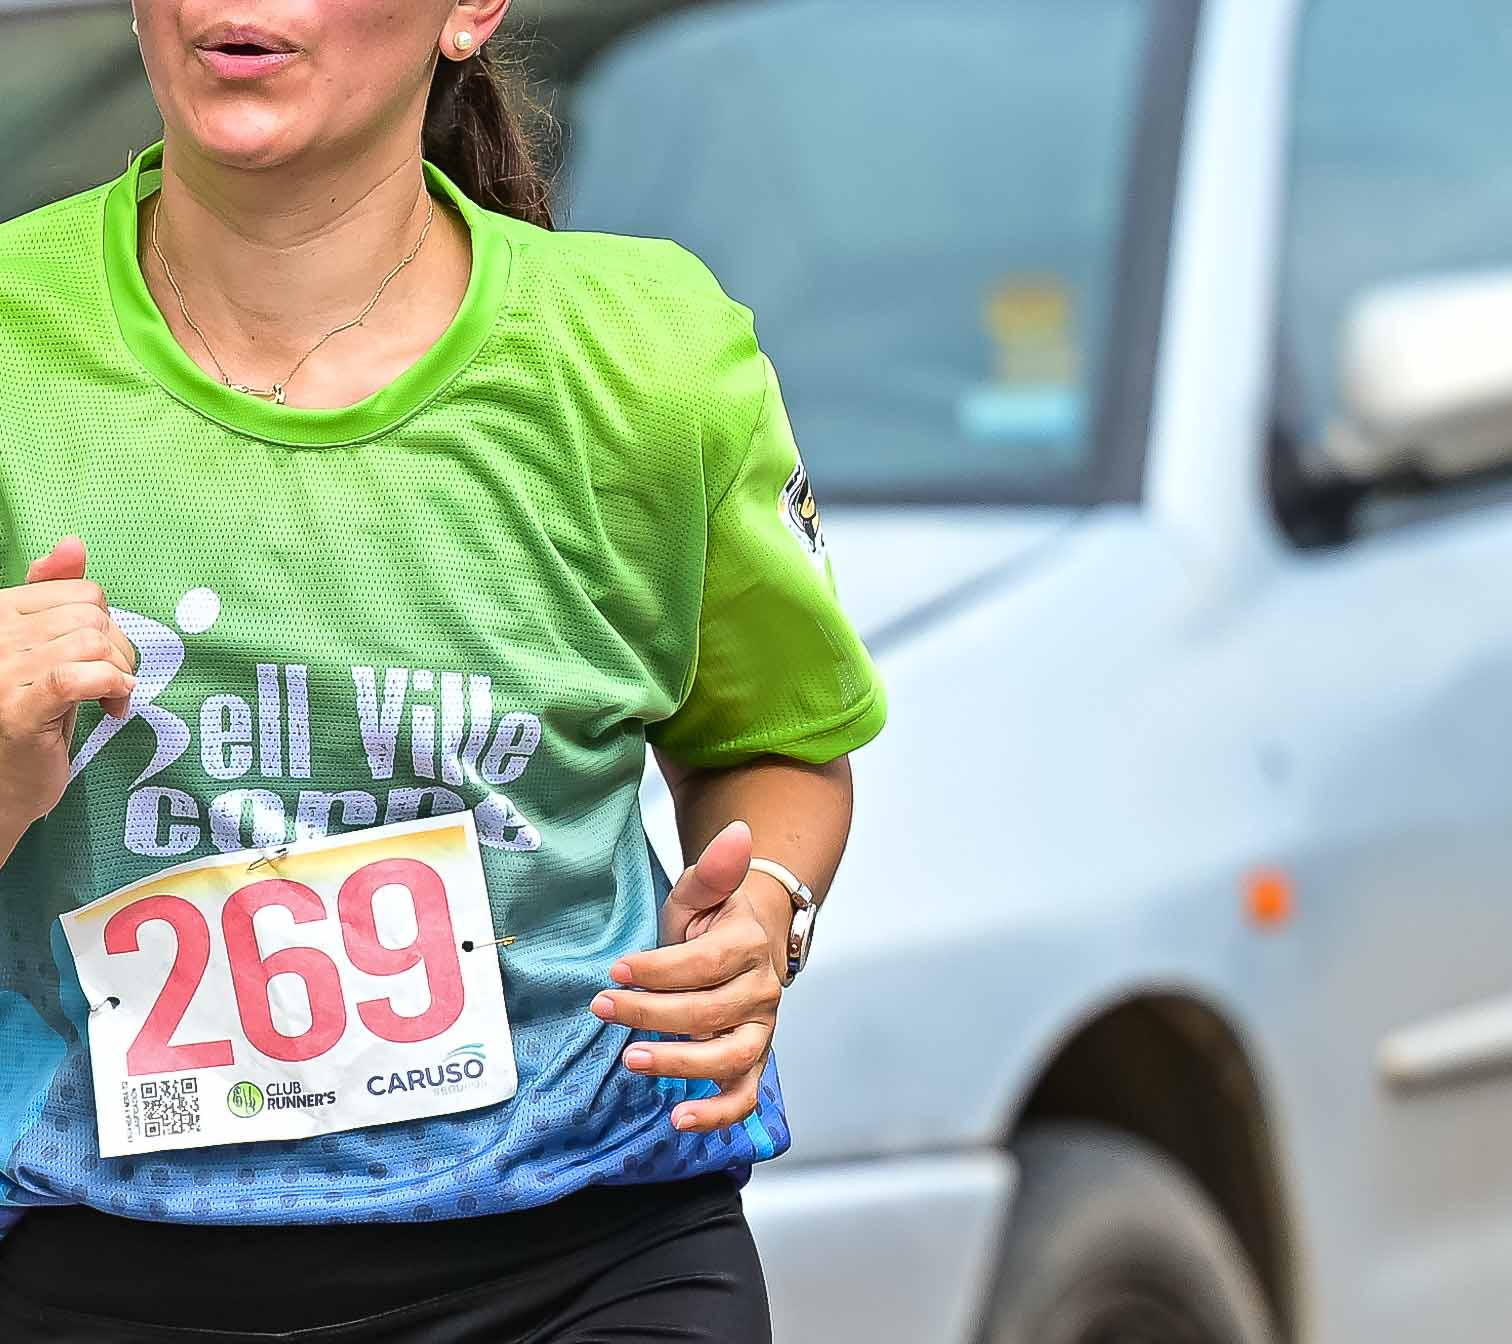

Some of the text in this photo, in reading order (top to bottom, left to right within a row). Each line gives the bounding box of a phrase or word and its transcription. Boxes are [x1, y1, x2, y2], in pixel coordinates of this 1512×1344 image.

[351, 664, 542, 786] Ville
[104, 857, 466, 1076] 269
[266, 1081, 302, 1097] CLUB
[366, 1058, 484, 1096] CARUSO
[267, 1091, 337, 1111] RUNNER'S
